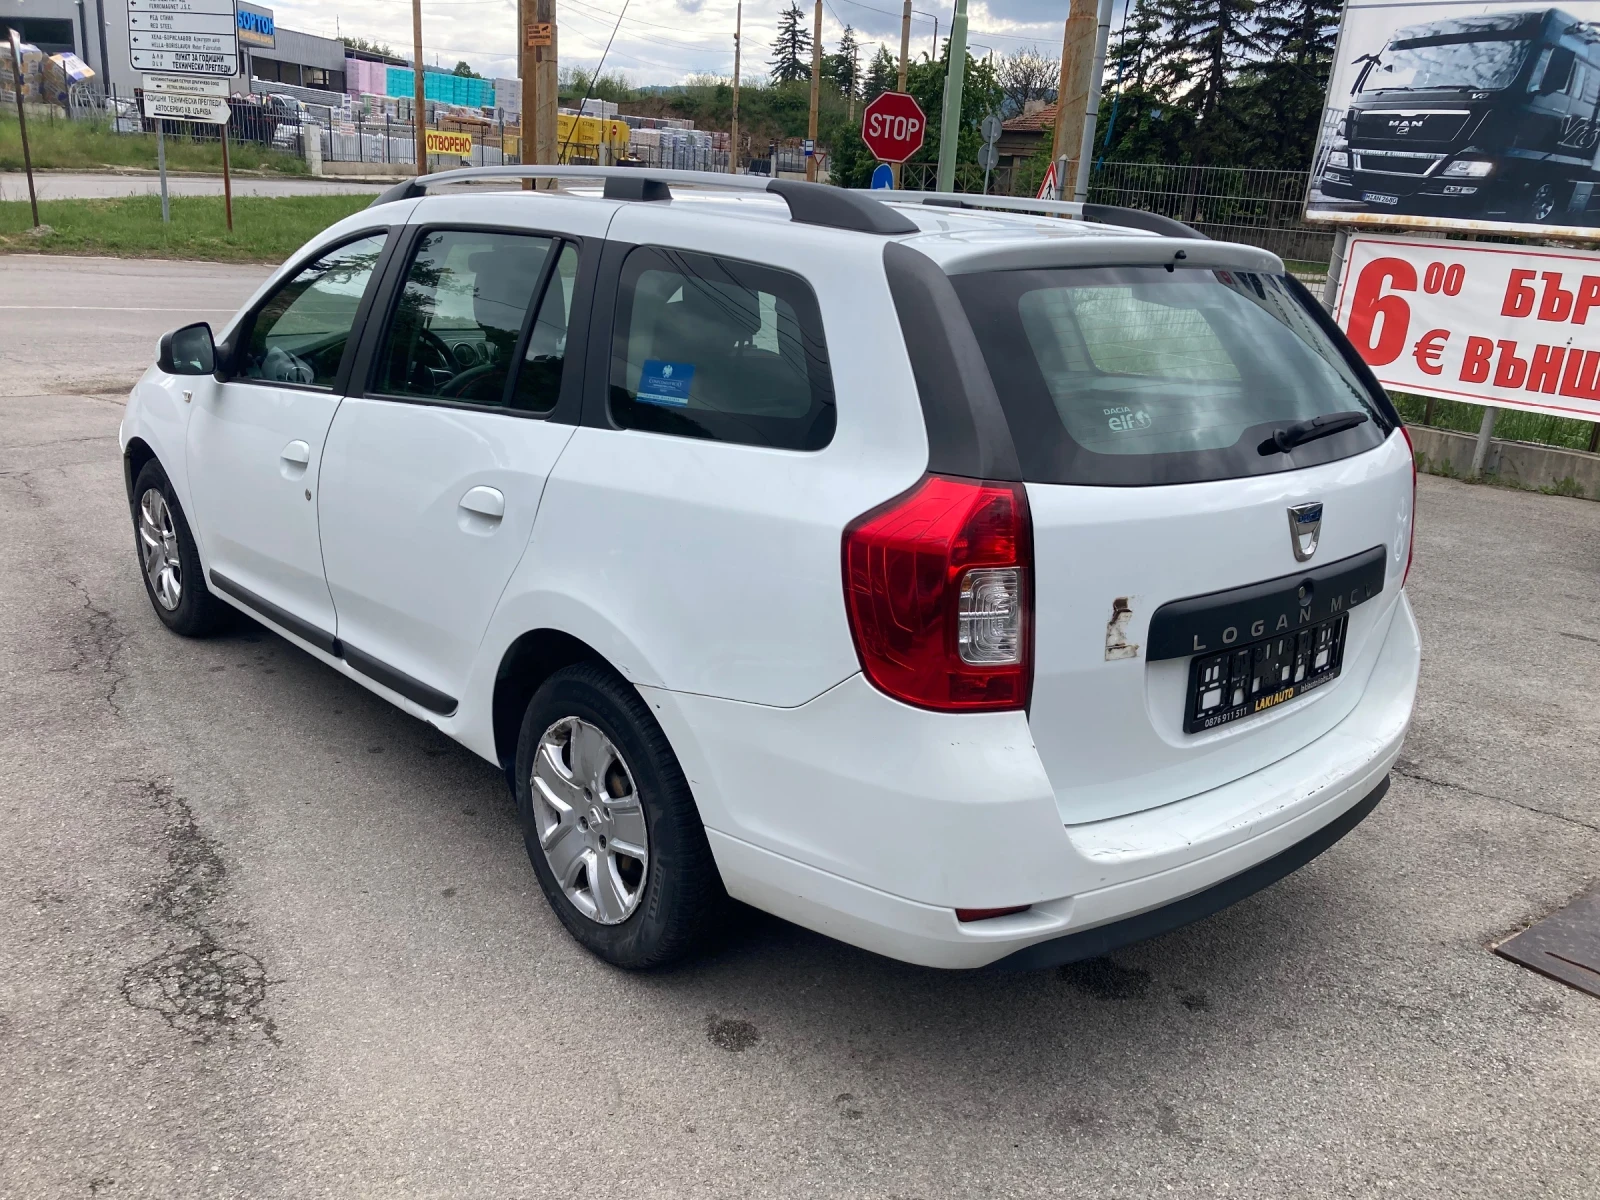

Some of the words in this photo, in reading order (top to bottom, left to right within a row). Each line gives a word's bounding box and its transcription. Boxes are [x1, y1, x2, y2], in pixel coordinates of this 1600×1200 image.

[172, 61, 204, 70] ТЕХНИЧЕСКИ
[205, 64, 231, 73] ПРЕГЛЕДИ
[199, 54, 224, 63] ГОДИШНИ
[145, 94, 167, 103] ГОДИШНИ
[168, 96, 197, 105] ТЕХНИЧЕСКИ
[198, 98, 222, 107] ПРЕГЛЕДИ
[156, 105, 184, 113] АВТОСЕРВИЗ
[869, 113, 920, 141] STOP
[426, 134, 472, 152] ОТВОРЕНО
[1500, 268, 1600, 325] БЪР
[1346, 257, 1418, 366] 6
[1423, 262, 1465, 296] 00
[1412, 329, 1451, 376] €
[1103, 406, 1130, 415] DACIA
[1109, 414, 1134, 430] elf
[1194, 606, 1312, 650] LOGAN
[1330, 584, 1372, 613] MCV
[1204, 715, 1221, 728] 0876
[1222, 711, 1234, 722] 911
[1235, 706, 1247, 718] 511
